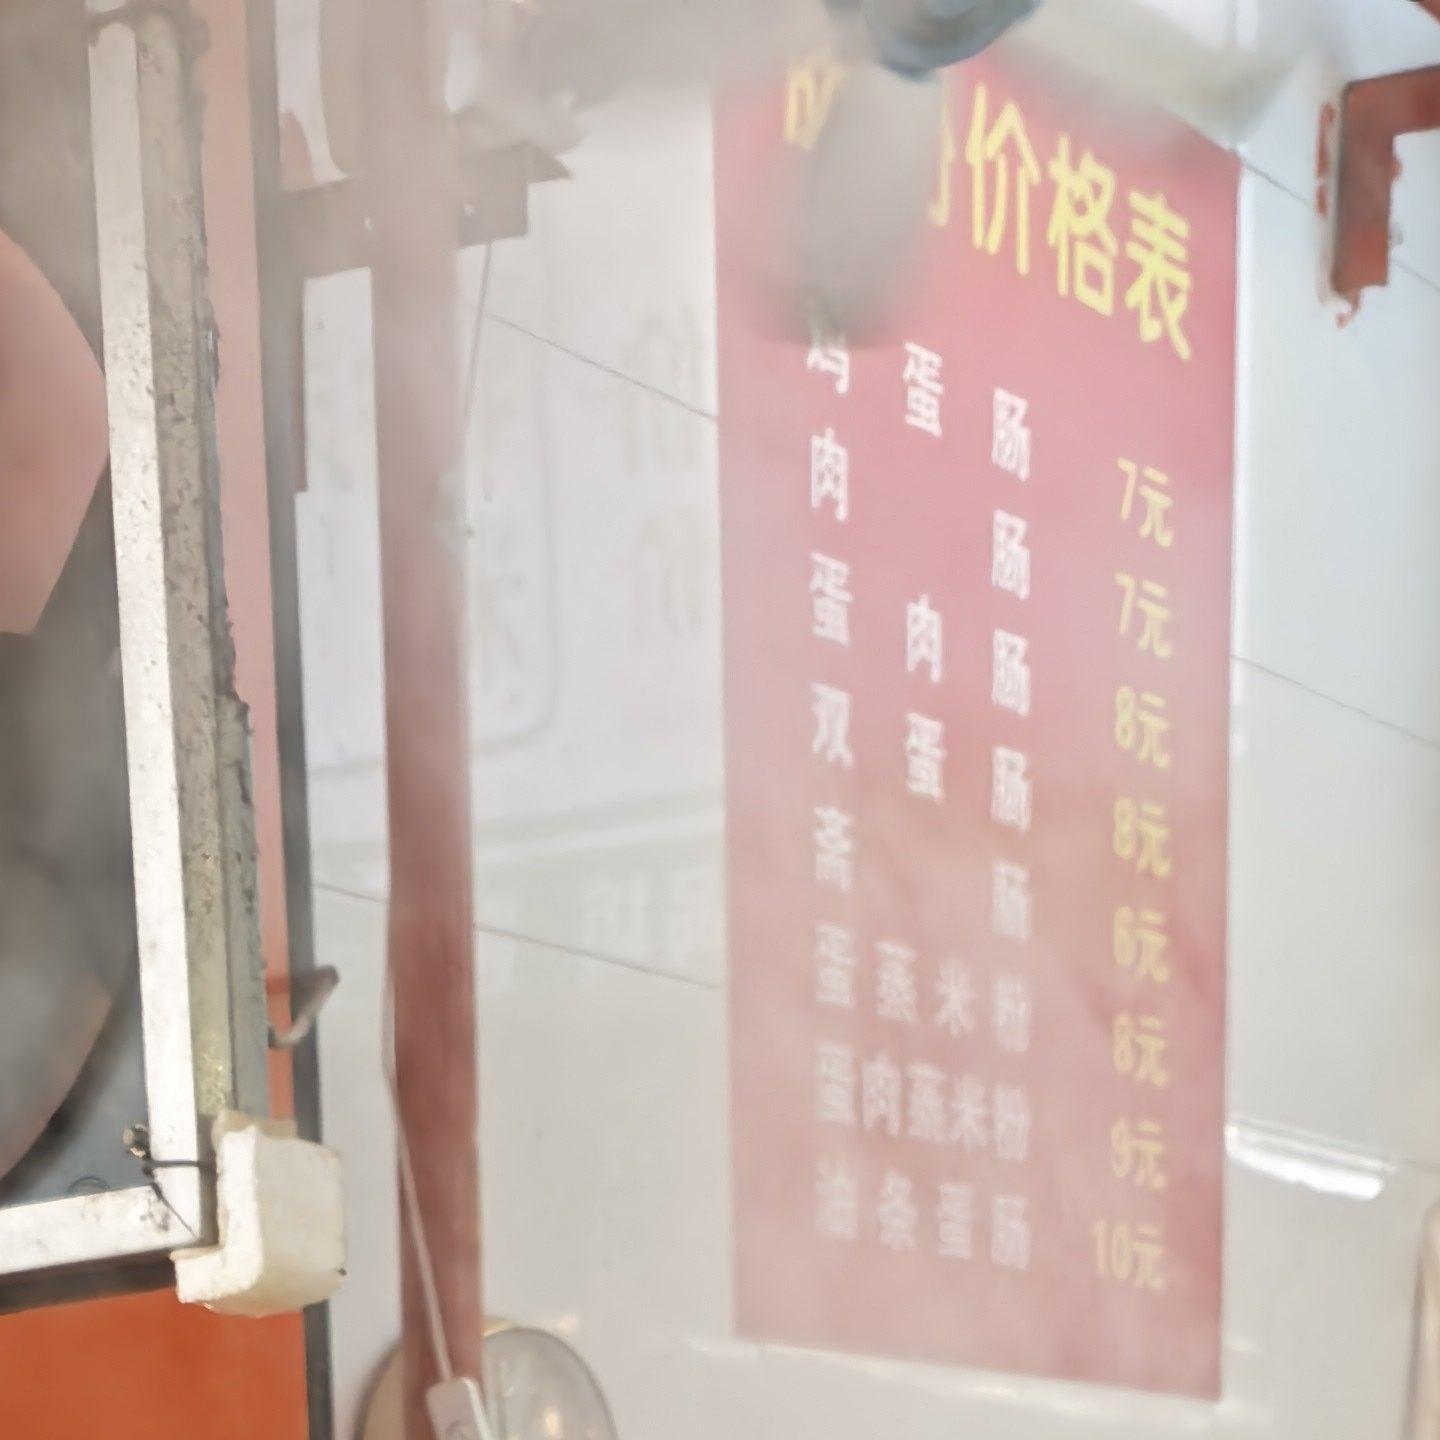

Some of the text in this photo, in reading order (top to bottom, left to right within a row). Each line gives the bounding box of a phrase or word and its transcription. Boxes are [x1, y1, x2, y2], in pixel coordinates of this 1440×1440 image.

[785, 48, 1192, 360] 价格表
[1116, 458, 1174, 548] 7元
[1115, 572, 1173, 659] 7元
[1114, 685, 1172, 768] 8元
[1090, 1219, 1166, 1291] 10元
